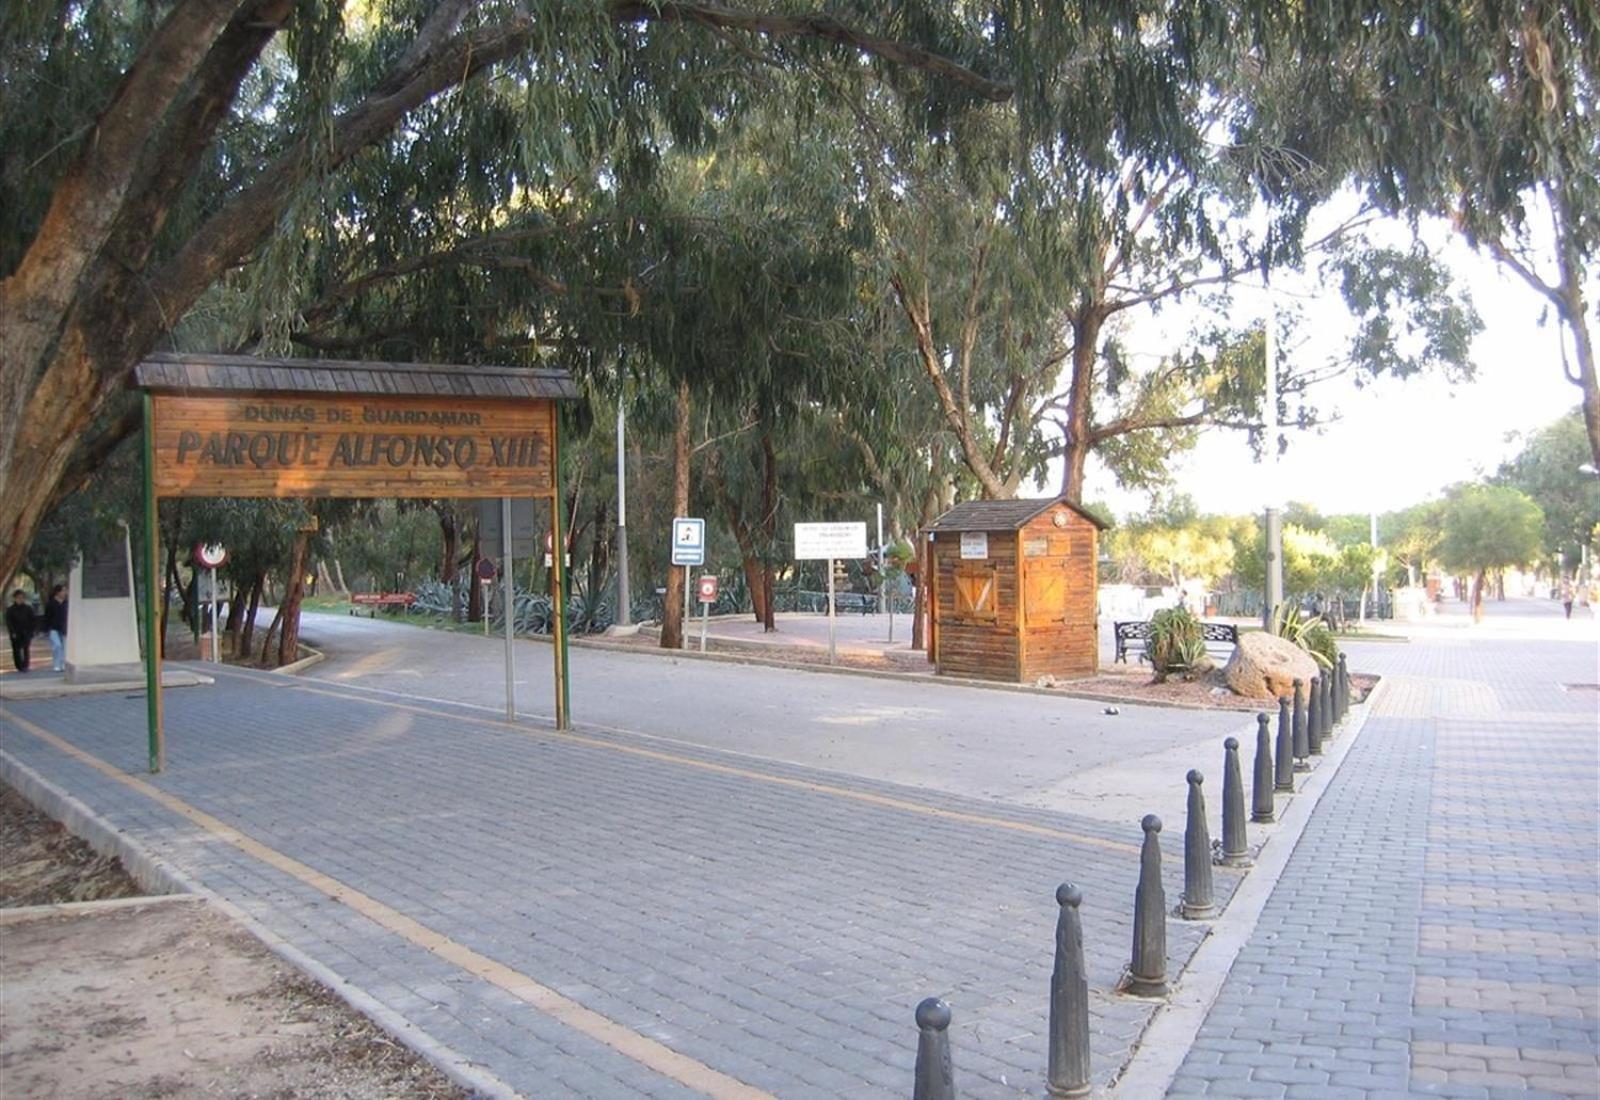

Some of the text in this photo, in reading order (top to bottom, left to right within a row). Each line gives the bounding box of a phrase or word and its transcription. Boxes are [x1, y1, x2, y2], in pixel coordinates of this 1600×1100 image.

[326, 407, 353, 422] DE
[363, 407, 482, 426] GUARDAMAR
[176, 431, 541, 469] PARQUE ALFONSO XIII
